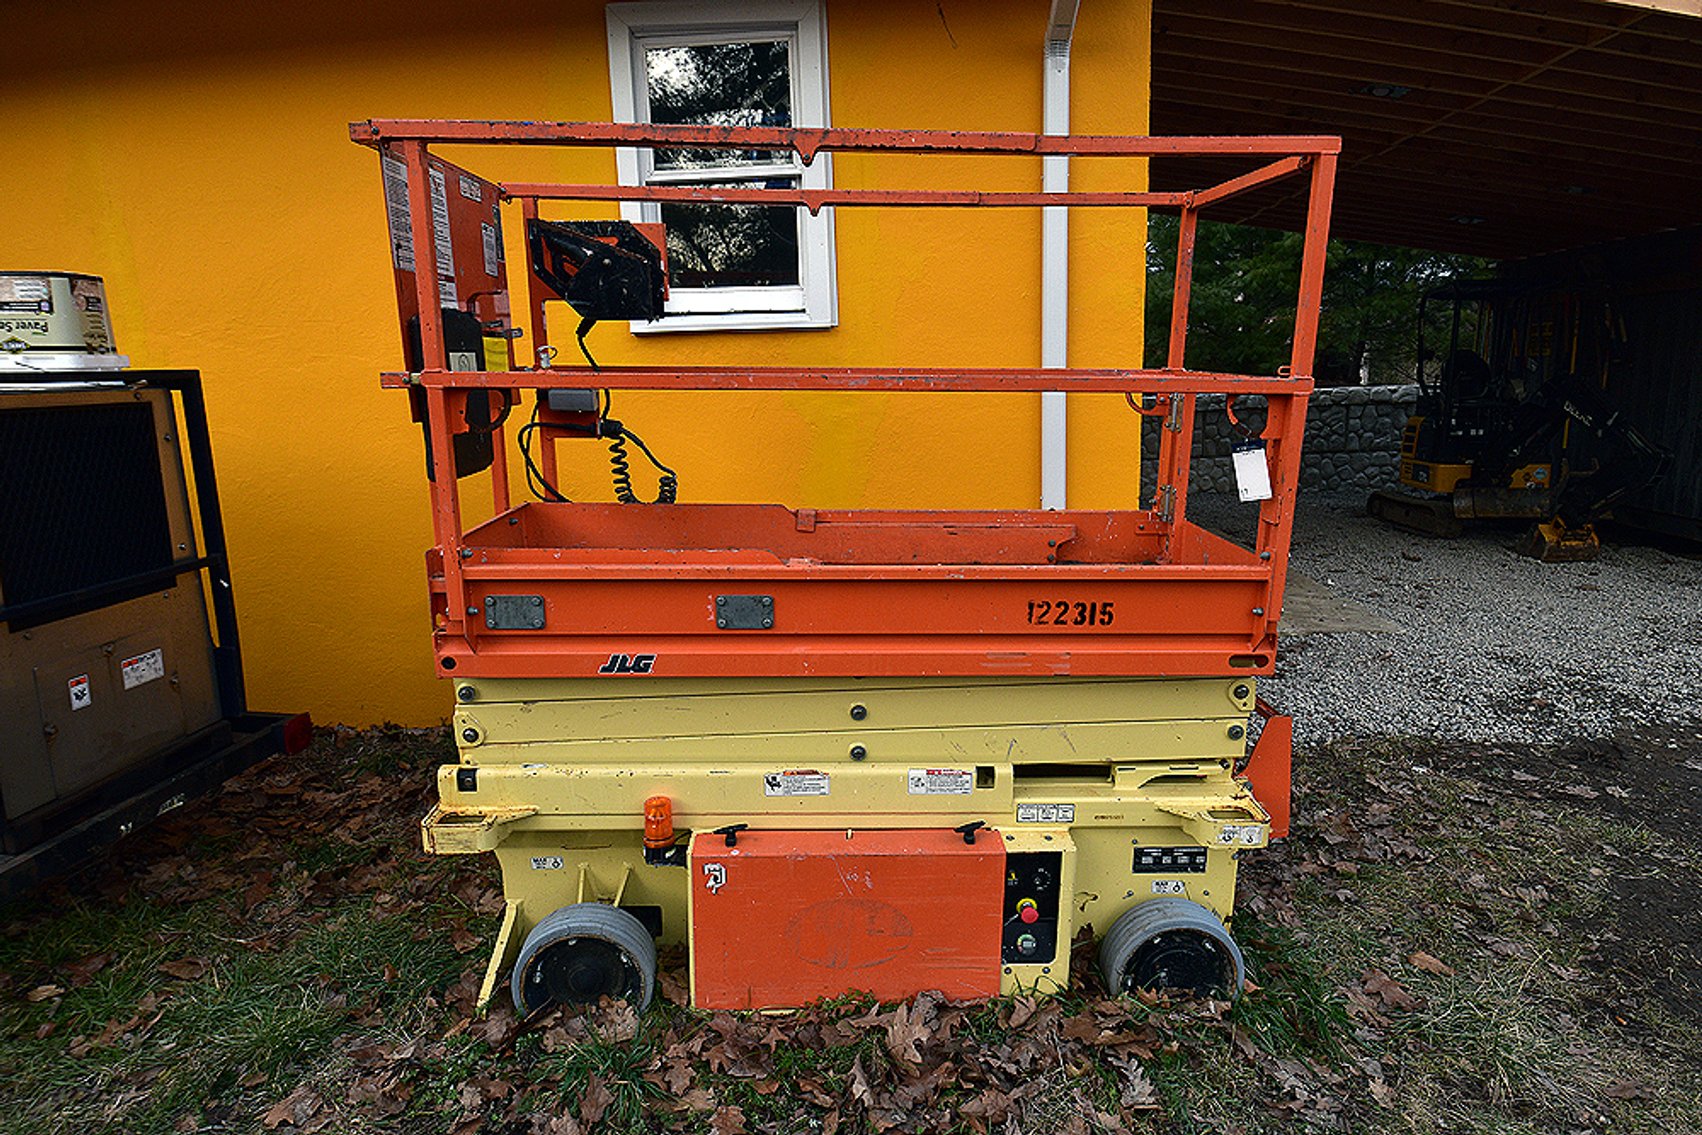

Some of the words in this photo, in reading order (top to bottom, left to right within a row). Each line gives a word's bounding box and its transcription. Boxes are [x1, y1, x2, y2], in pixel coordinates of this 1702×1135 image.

[16, 321, 49, 333] Paver
[1027, 601, 1115, 626] 122315
[599, 653, 657, 674] JLG
